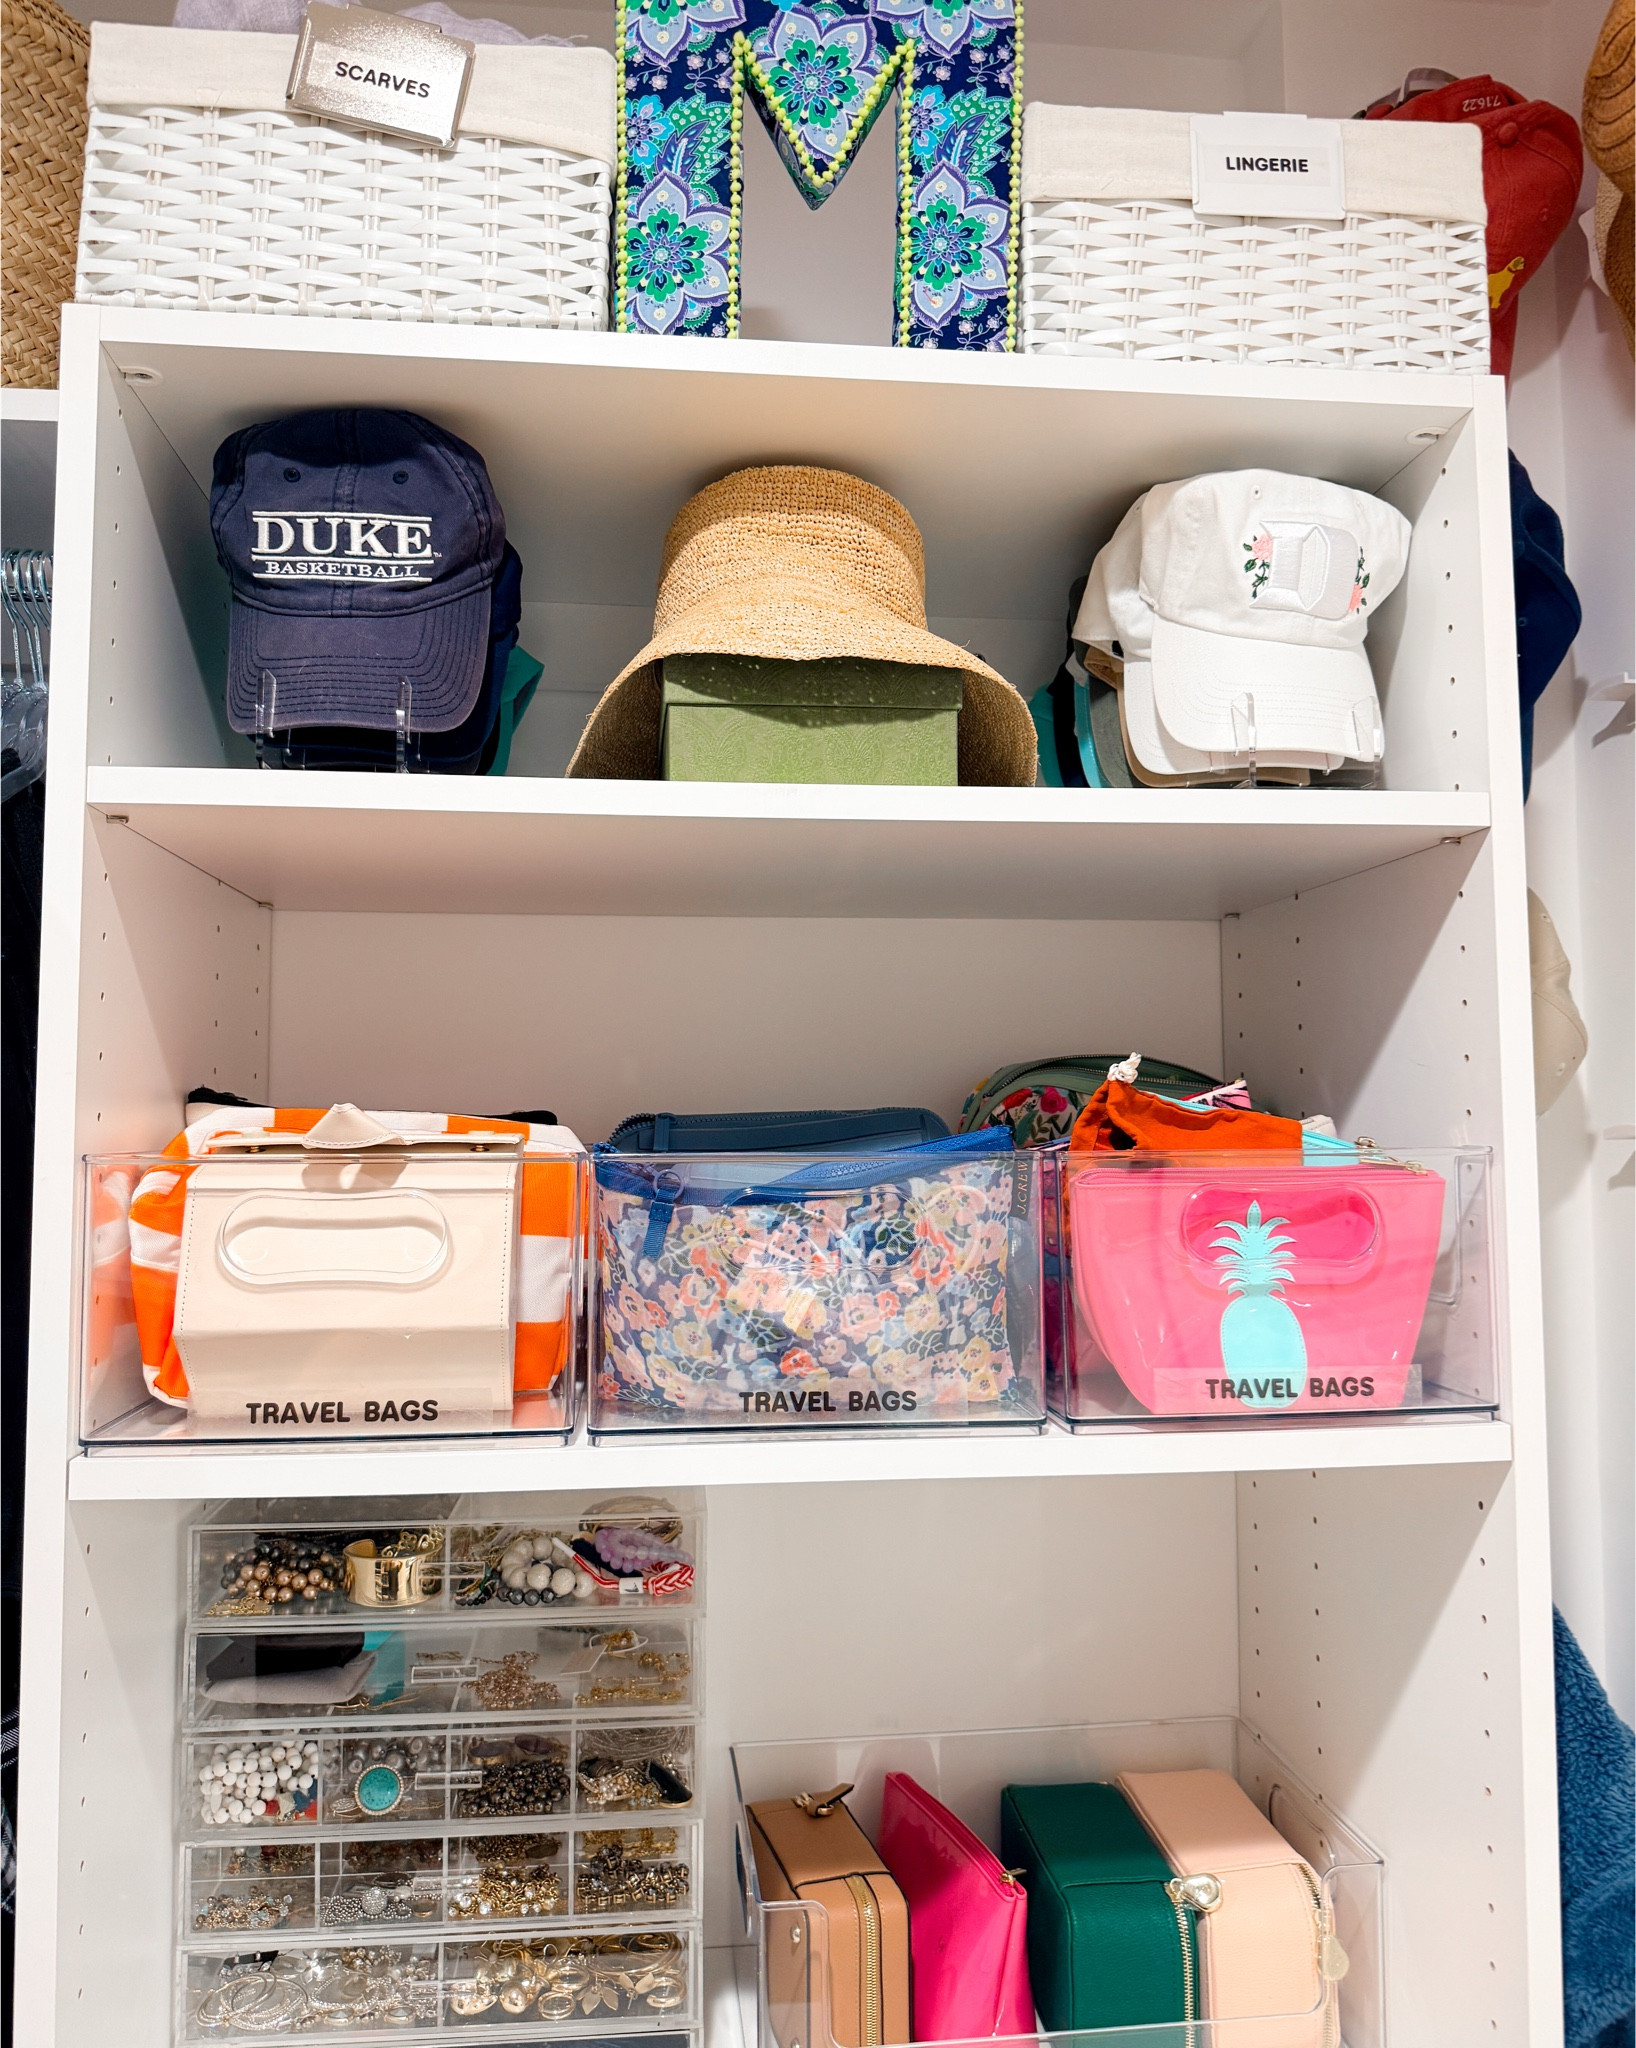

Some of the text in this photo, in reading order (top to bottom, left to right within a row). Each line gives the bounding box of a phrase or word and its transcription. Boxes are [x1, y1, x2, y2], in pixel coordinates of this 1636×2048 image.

[335, 61, 431, 98] SCARVES
[1226, 156, 1309, 173] LINGERIE
[251, 517, 433, 558] DUKE
[265, 561, 420, 578] BASKETBALL
[1016, 1160, 1028, 1215] J.CREW
[1205, 1376, 1375, 1399] TRAVEL BAGS
[246, 1400, 439, 1424] TRAVEL BAGS
[738, 1390, 917, 1413] TRAVEL BAGS
